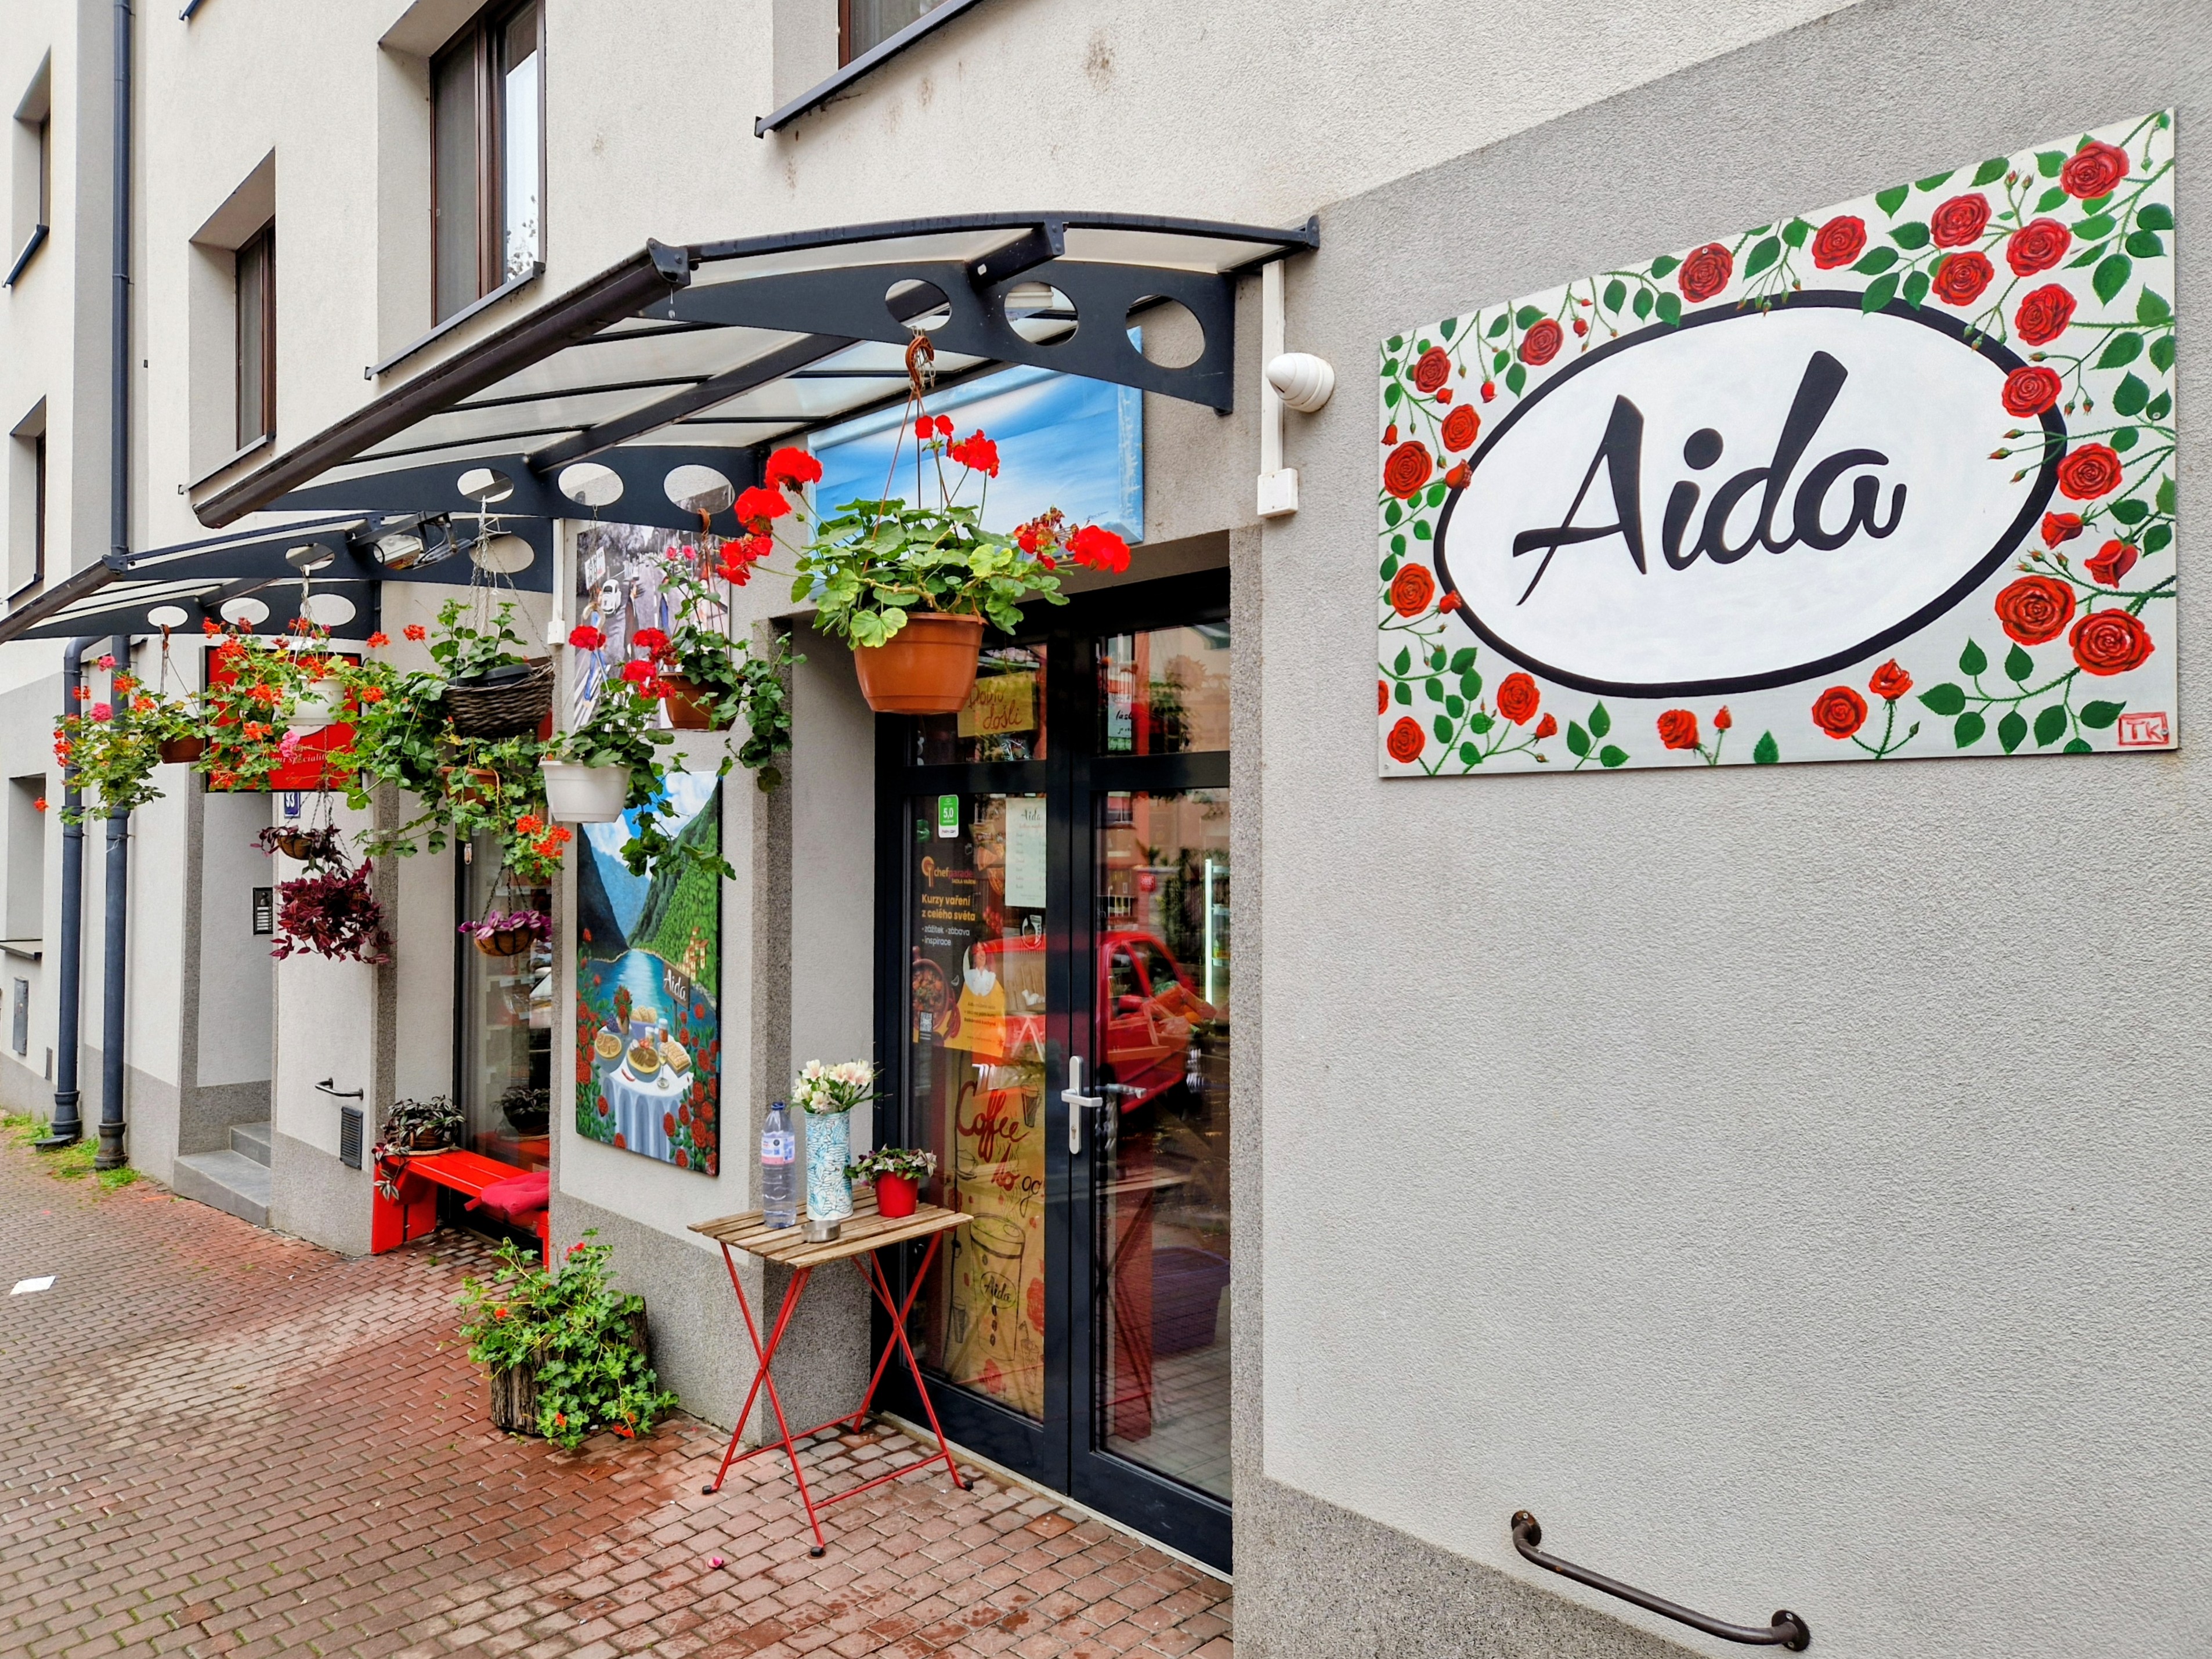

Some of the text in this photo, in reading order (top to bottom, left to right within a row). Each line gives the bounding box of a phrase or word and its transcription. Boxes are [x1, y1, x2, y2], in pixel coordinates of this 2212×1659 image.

[1513, 350, 1907, 606] Aida
[982, 699, 1022, 731] došli
[2126, 721, 2162, 740] TK
[943, 807, 954, 820] 5,0
[921, 894, 971, 907] Kurzy vaření
[927, 909, 953, 919] celého
[953, 912, 976, 921] světa
[924, 935, 952, 946] inspirace
[663, 968, 686, 1002] Aida
[956, 1080, 1030, 1163] Coffee
[1020, 1176, 1043, 1218] go
[984, 1275, 1011, 1303] Aida
